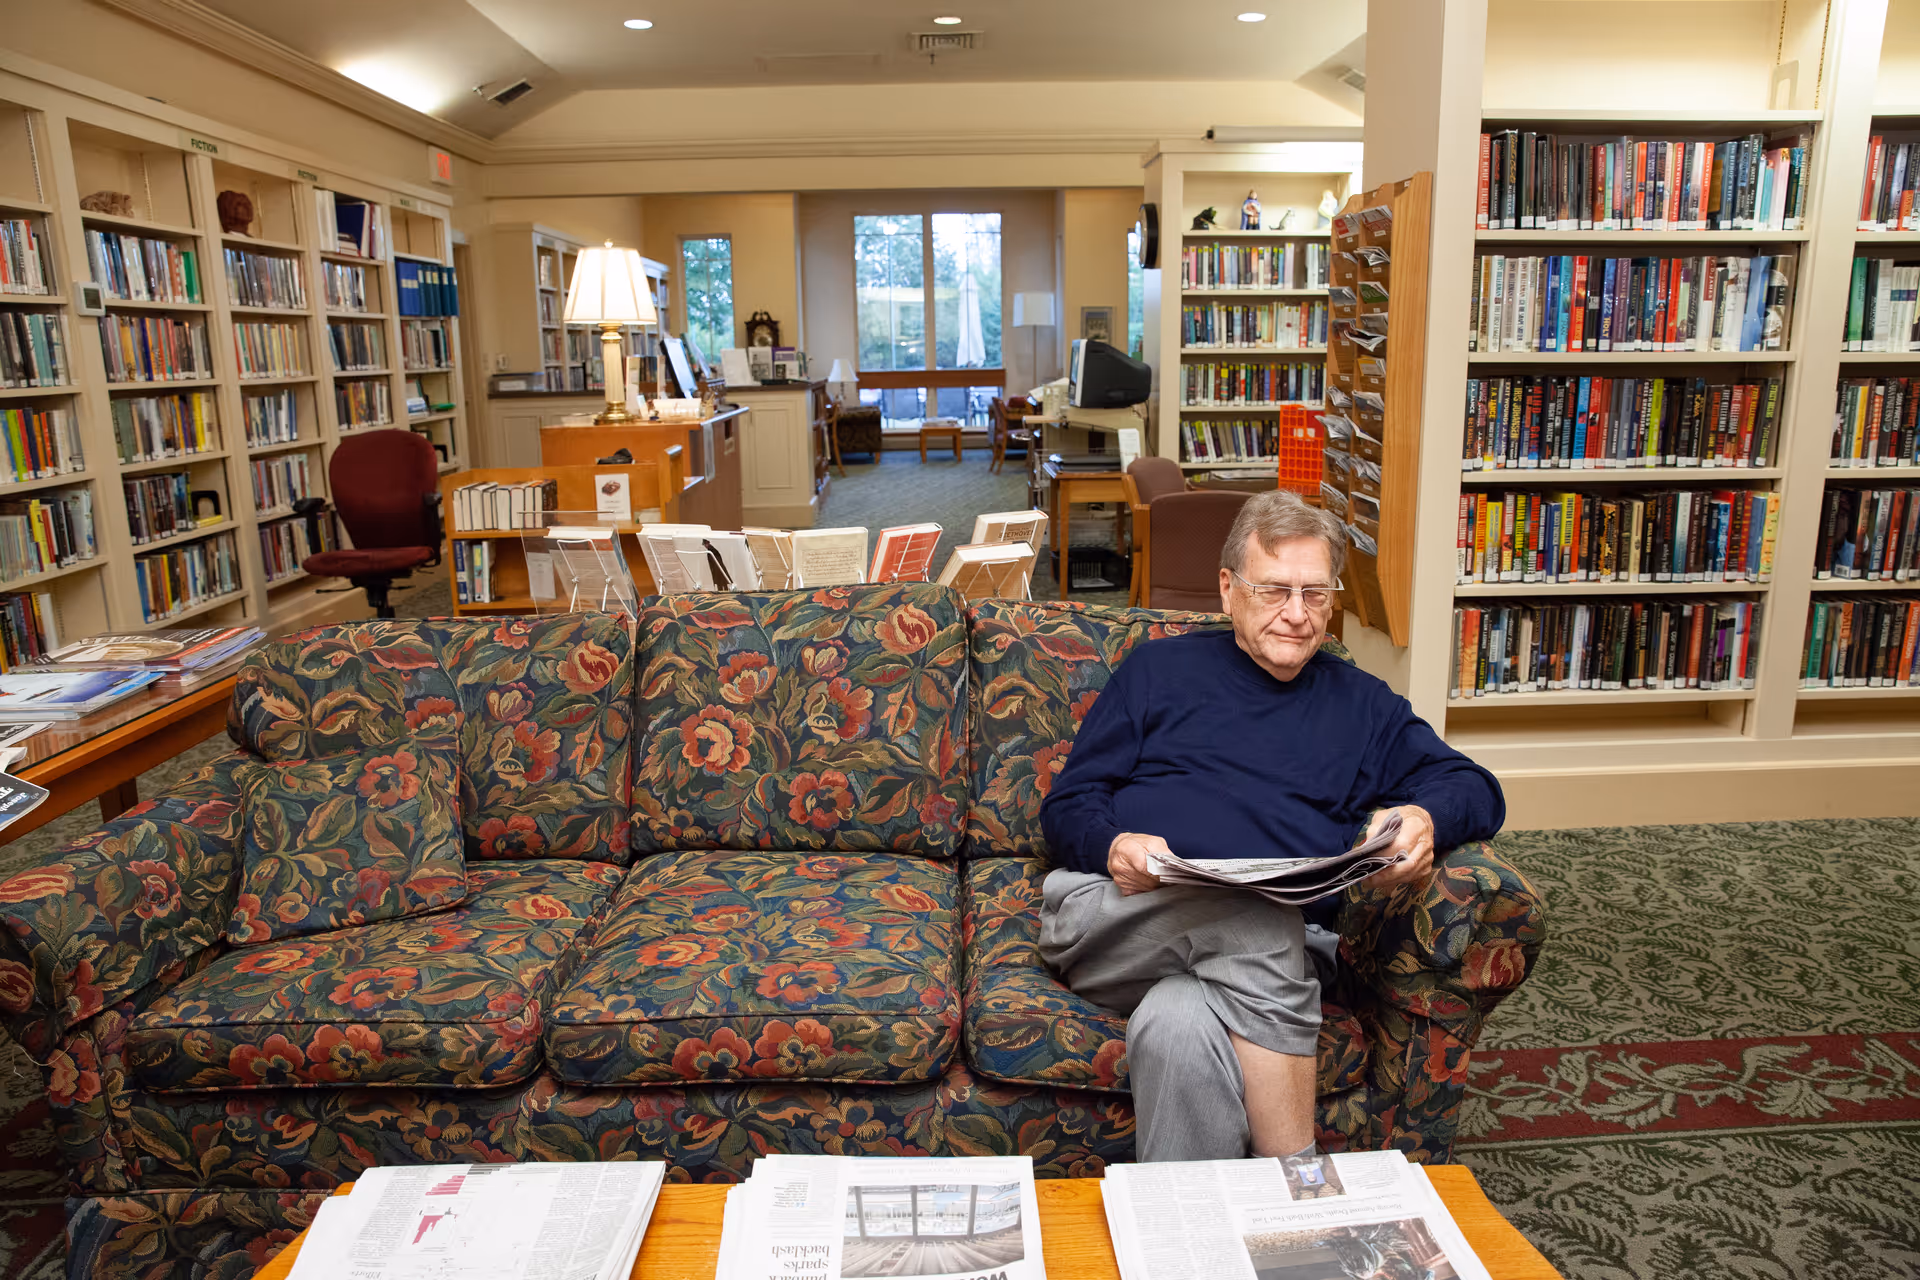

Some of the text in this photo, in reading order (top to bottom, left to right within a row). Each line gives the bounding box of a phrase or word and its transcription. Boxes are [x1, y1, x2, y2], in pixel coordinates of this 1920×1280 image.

[190, 138, 218, 154] FICTION
[1532, 387, 1542, 413] MIND
[1728, 389, 1742, 434] FAYE KELLERMAN
[1511, 388, 1522, 438] IRIS JOHANSEN
[1719, 402, 1729, 431] KELLERMAN
[1747, 401, 1757, 431] KELLERMAN
[1875, 536, 1884, 550] CROSS
[1528, 551, 1536, 574] MOTIVE
[1842, 611, 1852, 635] SAIL
[772, 1246, 830, 1258] backlash
[784, 1258, 828, 1272] sparks
